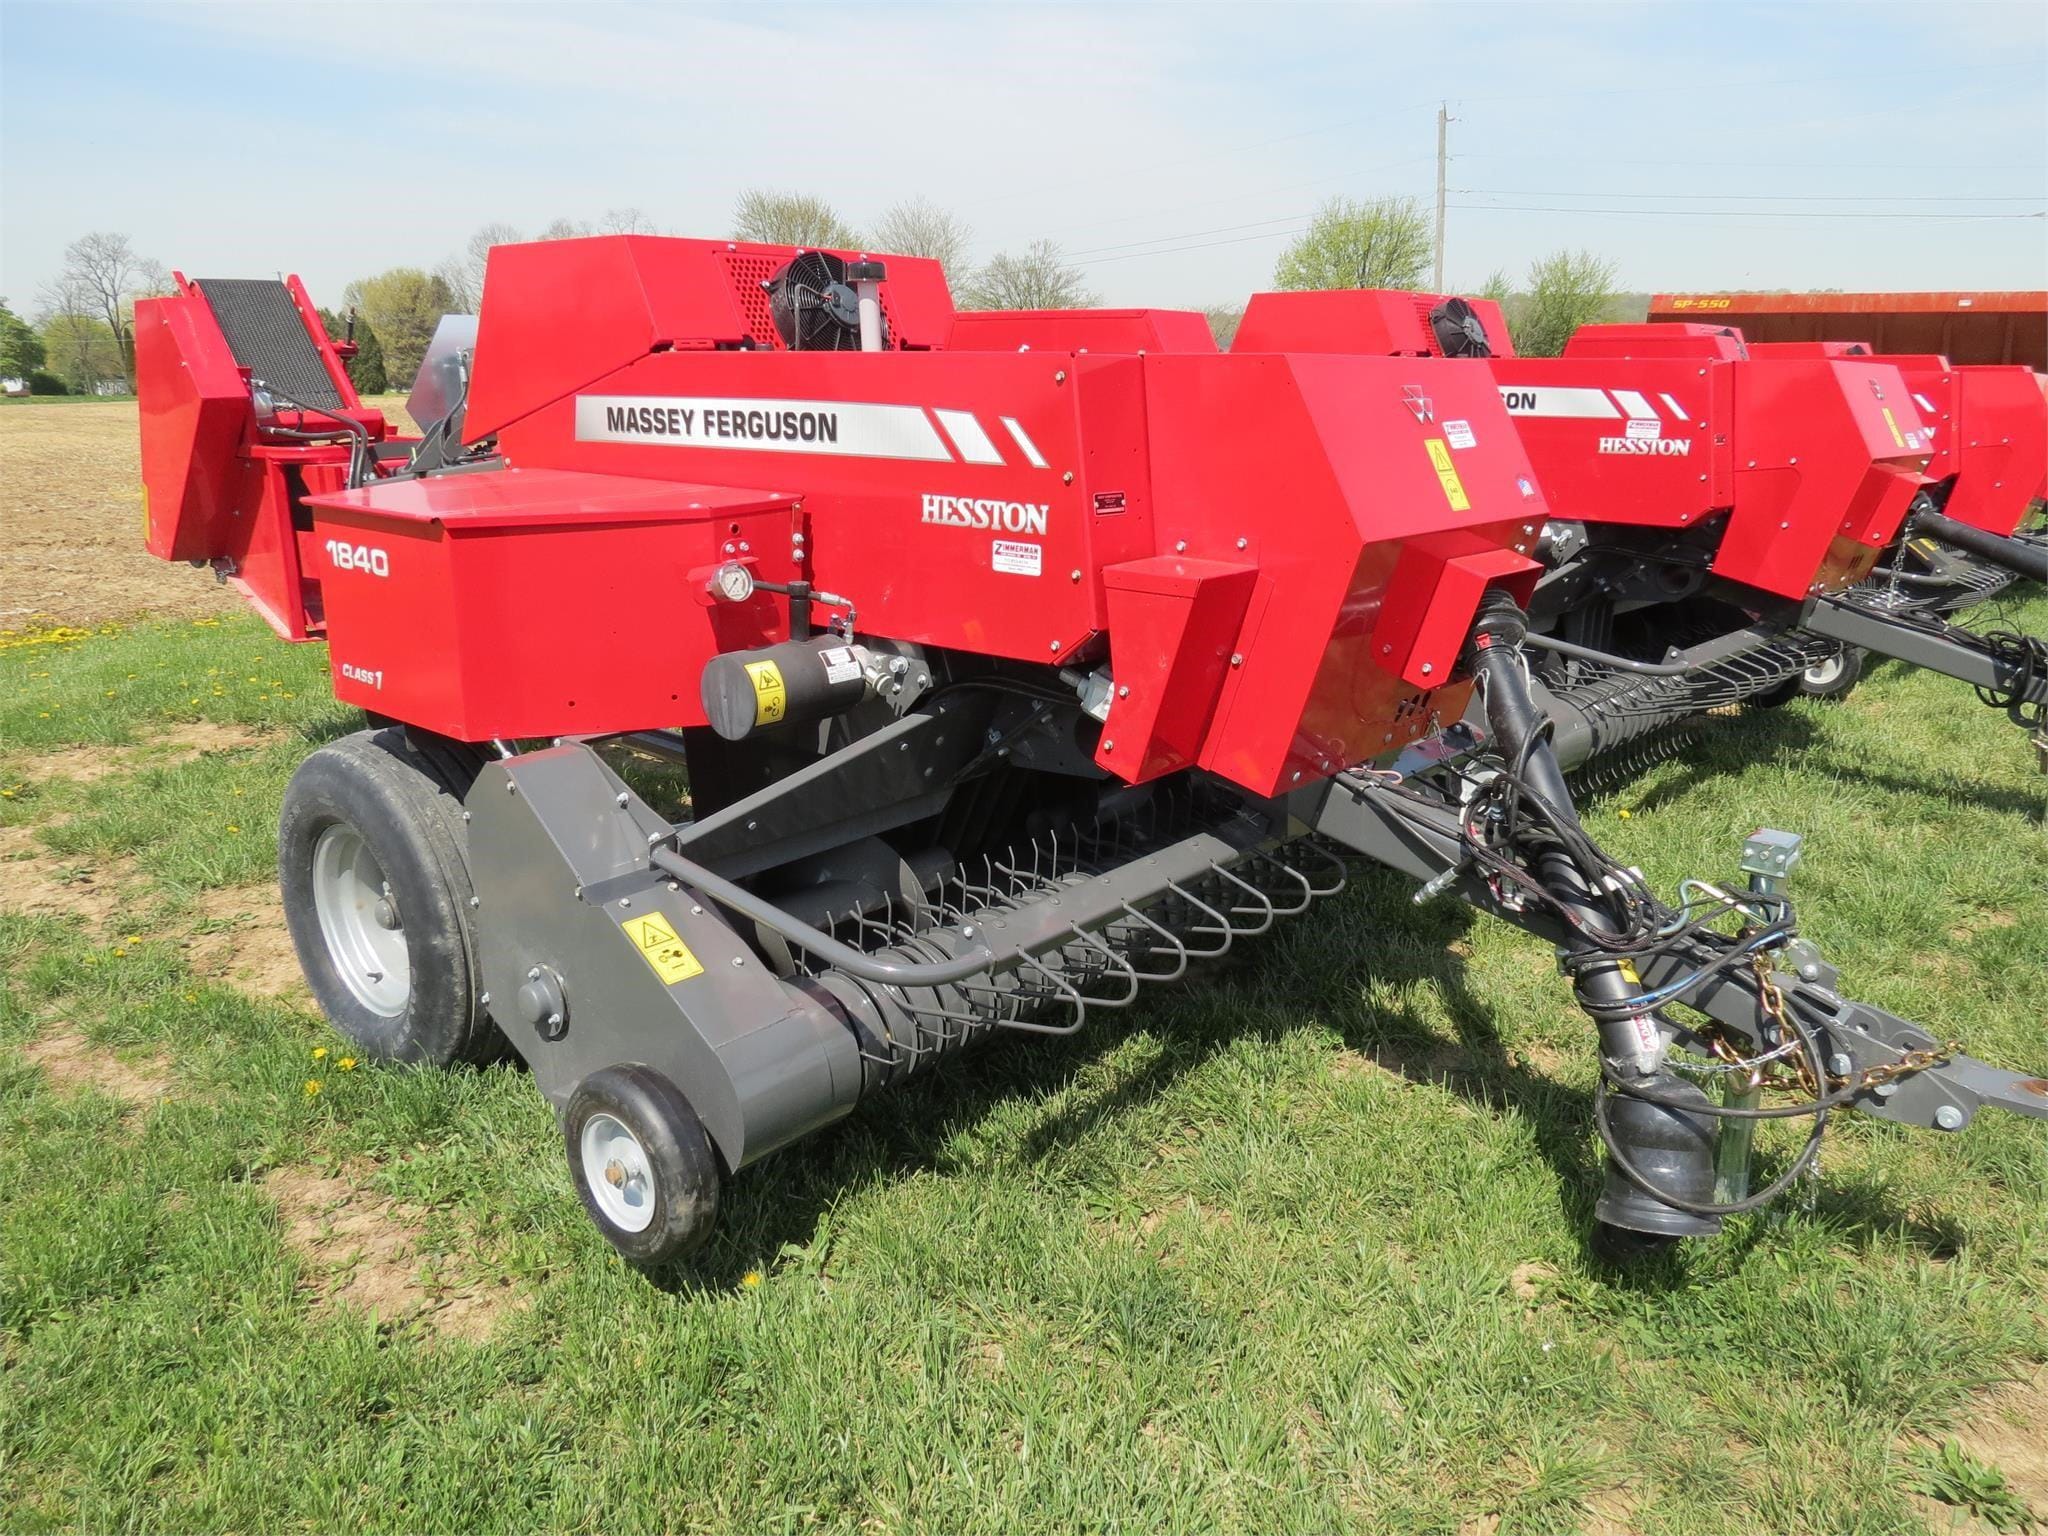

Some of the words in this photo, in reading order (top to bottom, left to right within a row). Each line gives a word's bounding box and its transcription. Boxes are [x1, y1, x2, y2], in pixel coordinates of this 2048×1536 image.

[1672, 299, 1731, 309] SP-550
[1500, 392, 1537, 410] ON
[606, 406, 695, 436] MASSEY
[703, 410, 838, 443] FERGUSON
[1598, 437, 1692, 457] HESSTON
[921, 494, 1049, 535] HESSTON
[326, 540, 389, 577] 1840
[995, 543, 1039, 555] ZIMMERMAN
